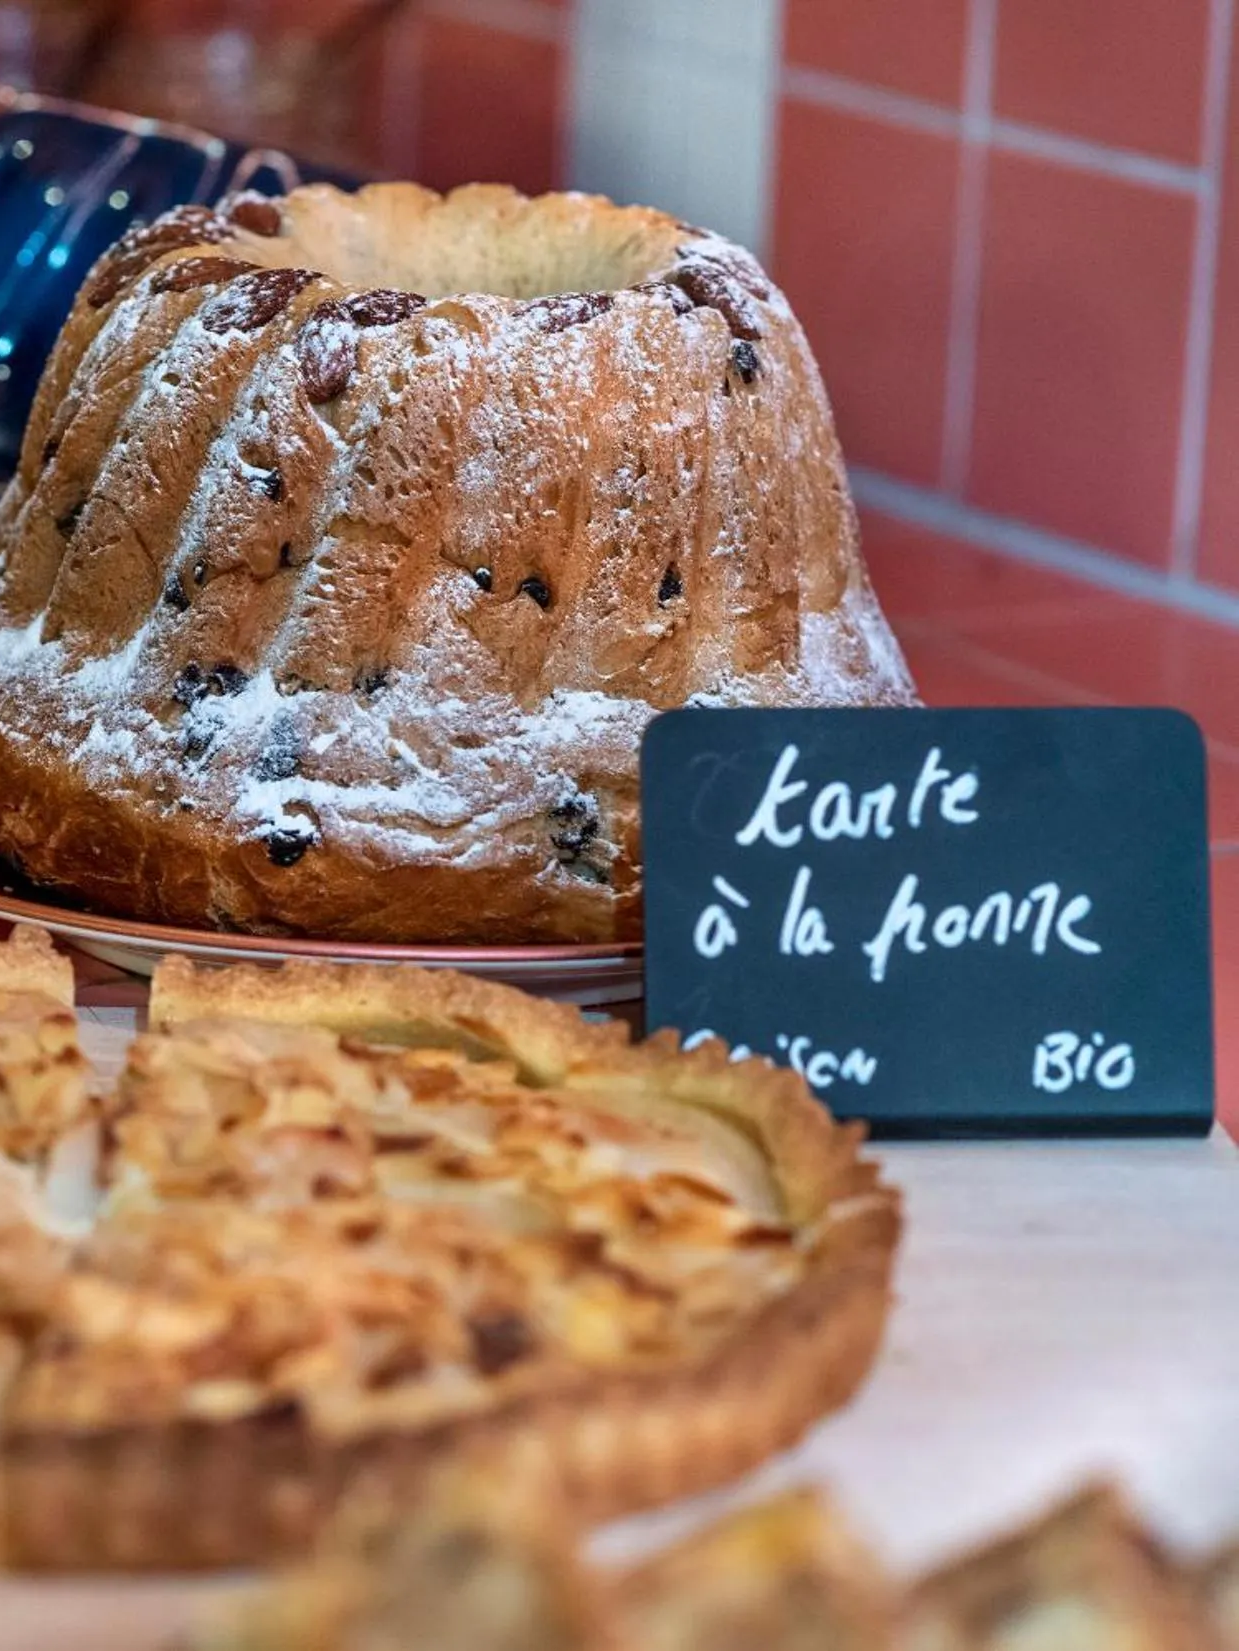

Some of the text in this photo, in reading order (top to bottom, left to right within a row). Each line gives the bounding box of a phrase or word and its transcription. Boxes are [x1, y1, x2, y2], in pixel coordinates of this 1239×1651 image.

[735, 743, 981, 847] tarte
[693, 875, 750, 958] à
[780, 866, 835, 956] la
[1032, 1031, 1135, 1093] Bio
